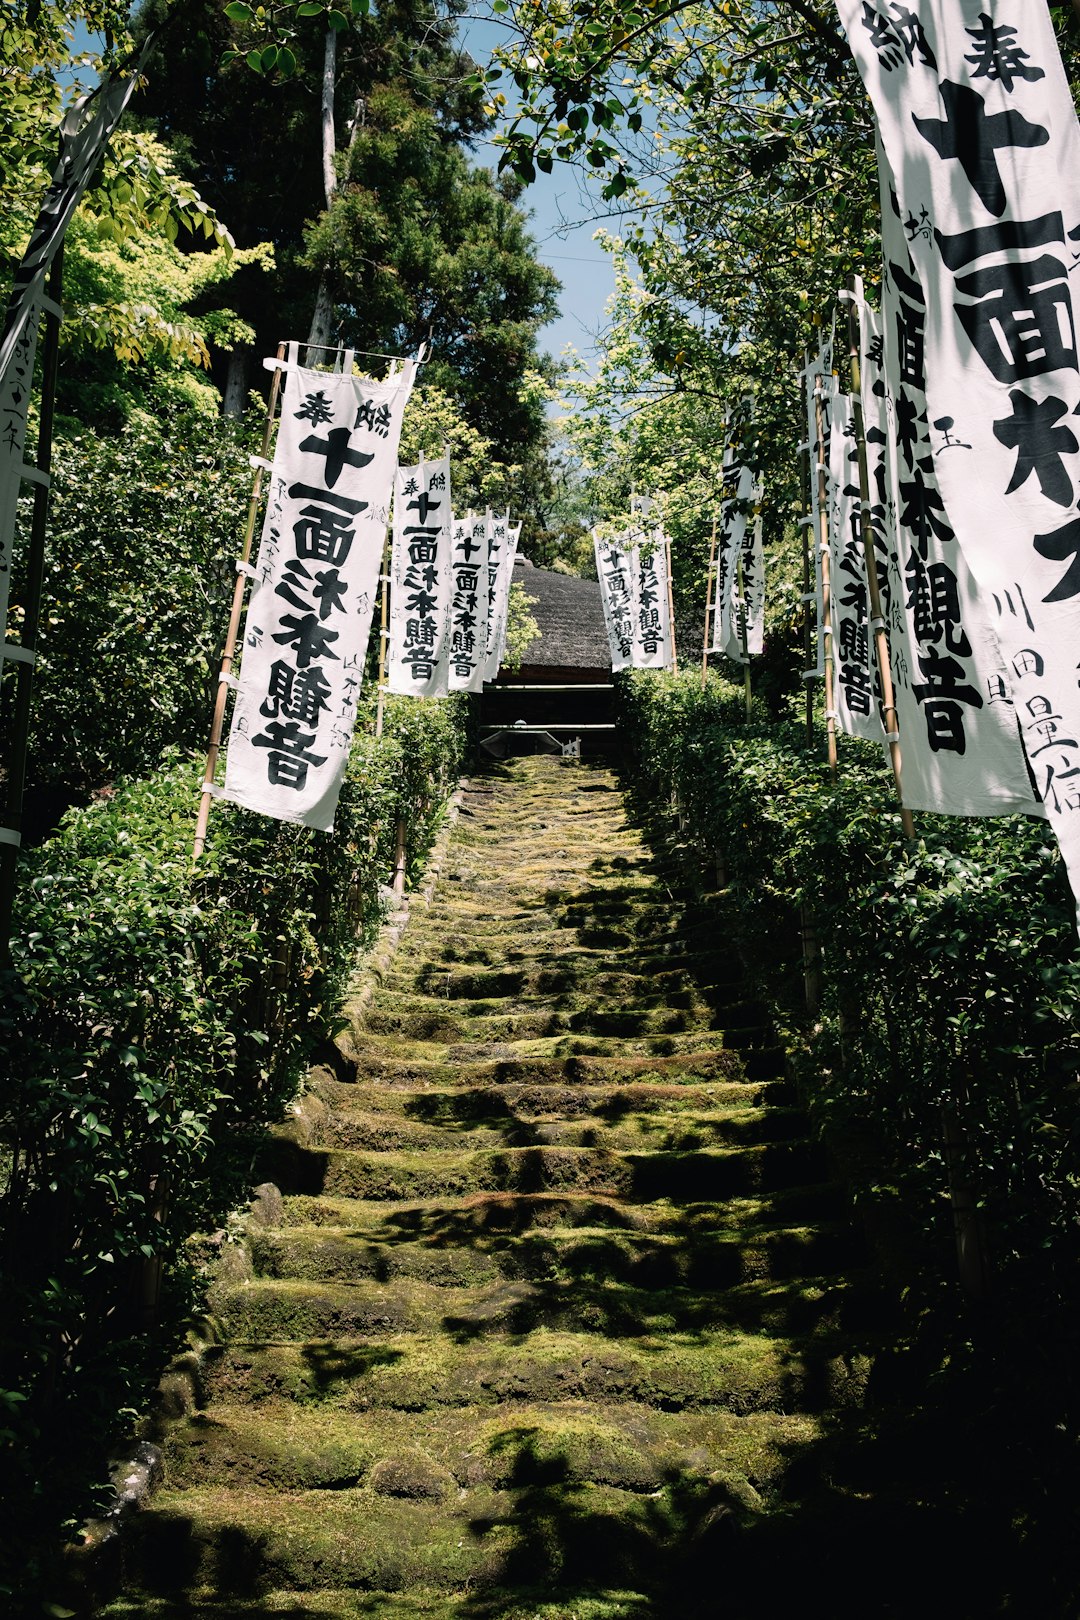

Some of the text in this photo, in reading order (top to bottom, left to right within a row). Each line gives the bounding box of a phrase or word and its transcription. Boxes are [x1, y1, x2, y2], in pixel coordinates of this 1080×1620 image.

[603, 550, 634, 658] 十一面杉本観音
